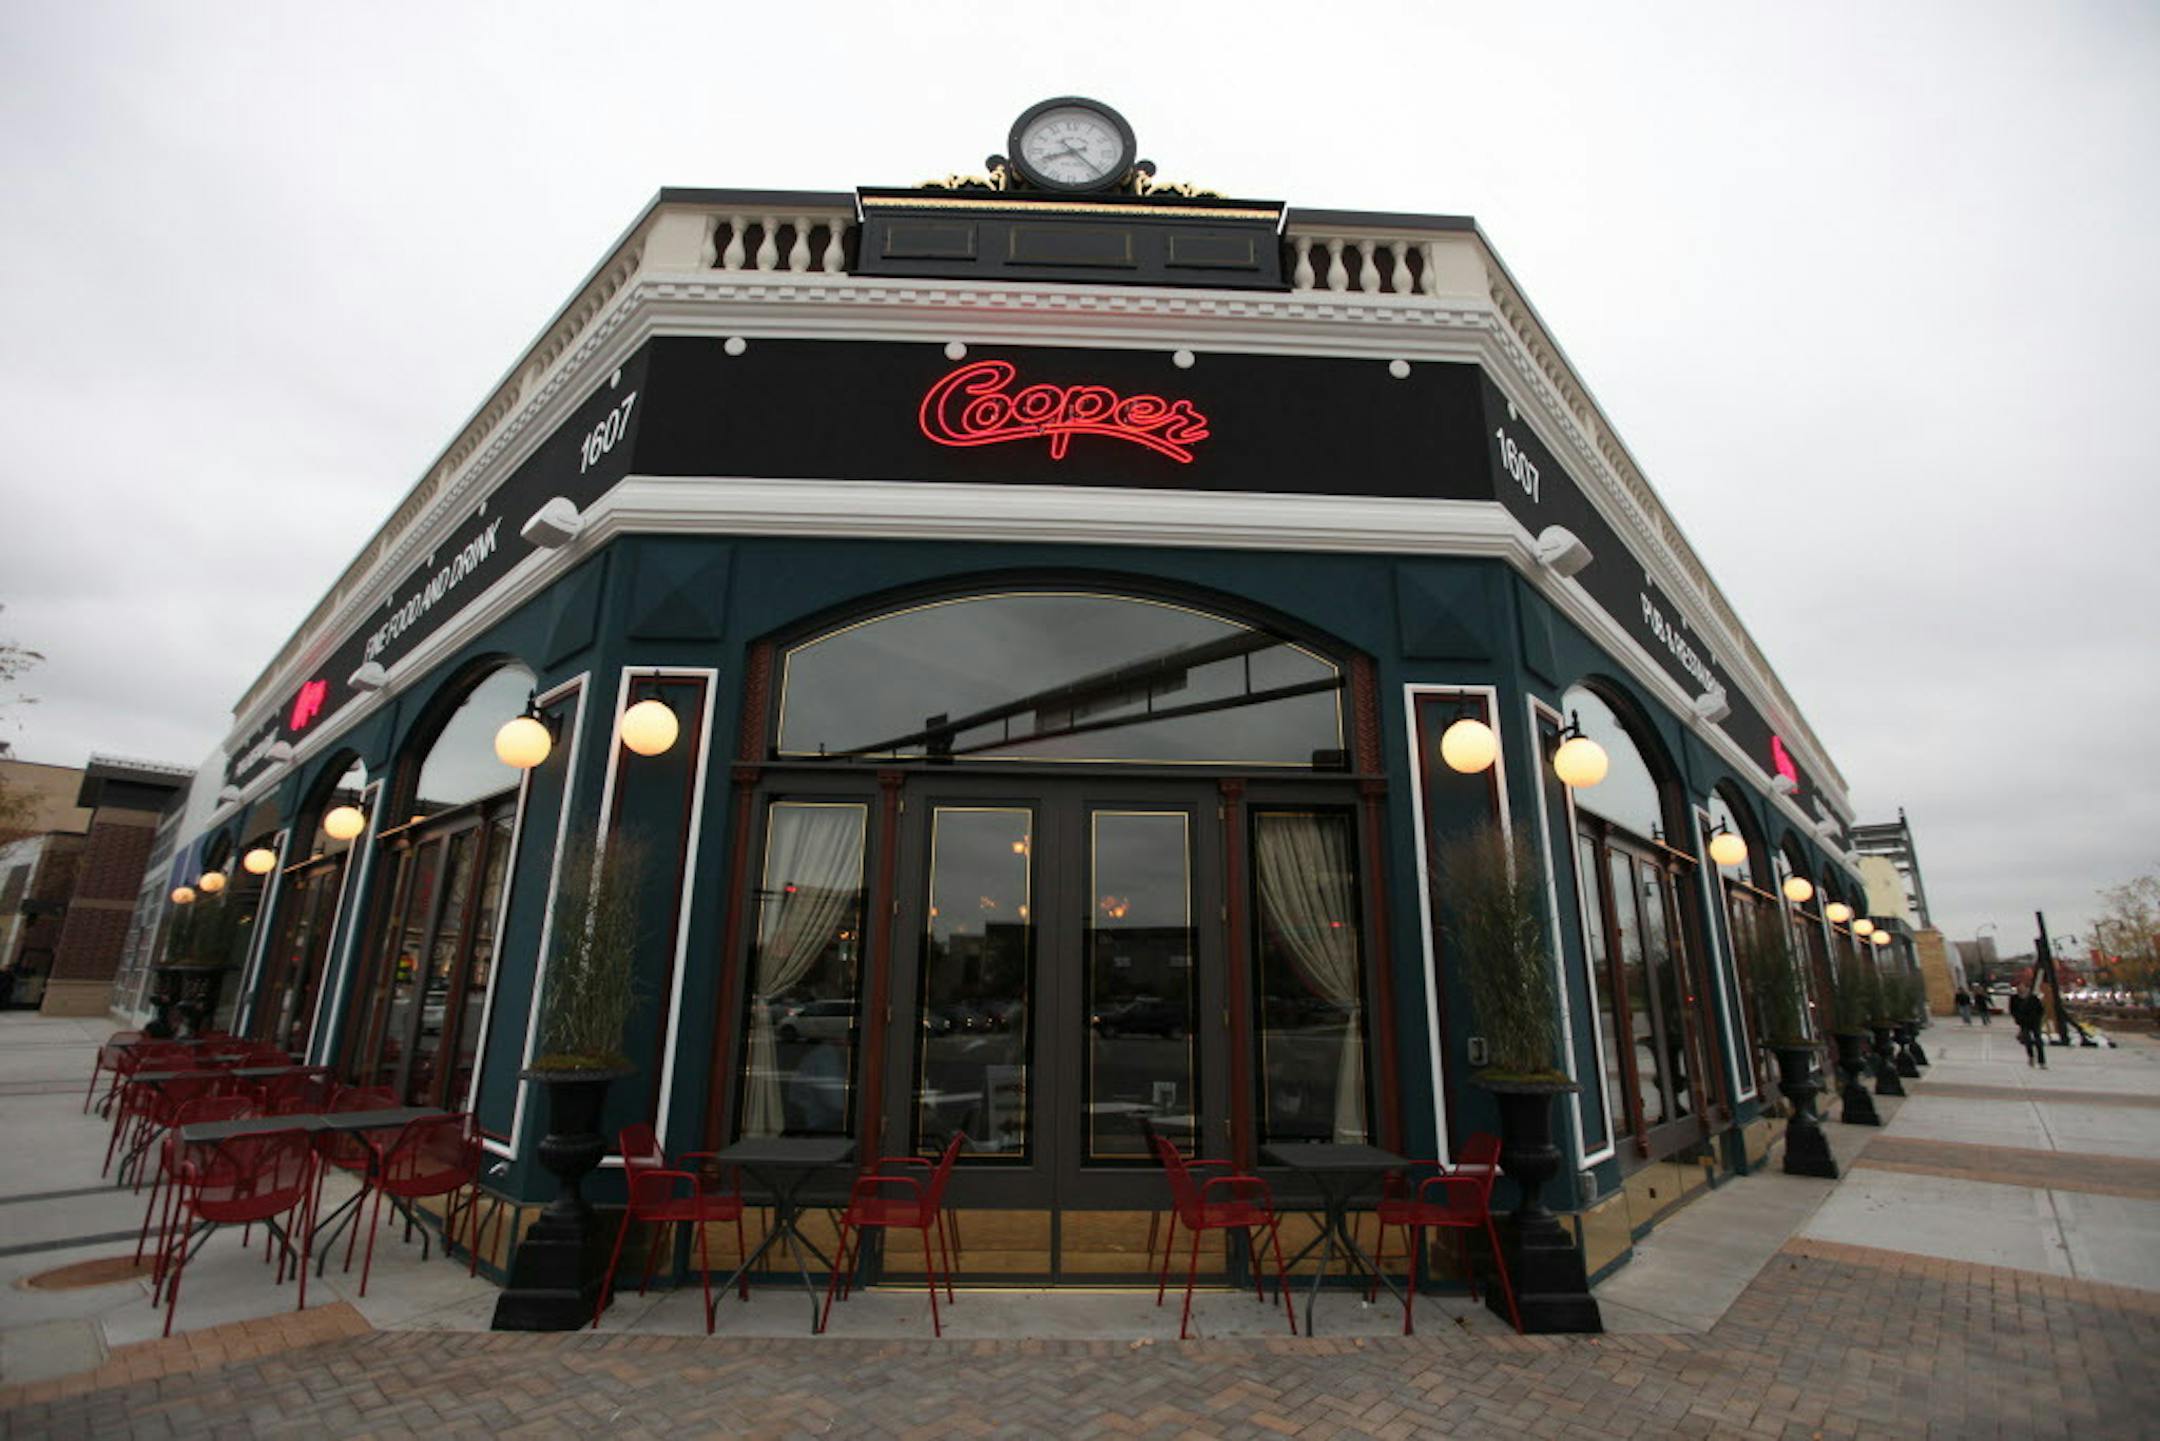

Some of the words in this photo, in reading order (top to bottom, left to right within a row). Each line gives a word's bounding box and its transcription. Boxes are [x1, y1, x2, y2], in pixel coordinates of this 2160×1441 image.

[580, 391, 637, 474] 1607
[919, 360, 1209, 464] Cooper
[1496, 427, 1540, 504] 1607
[385, 592, 423, 646] FOOD
[421, 566, 450, 611] AND
[448, 516, 502, 590] DRINK
[1640, 592, 1666, 643] PUB
